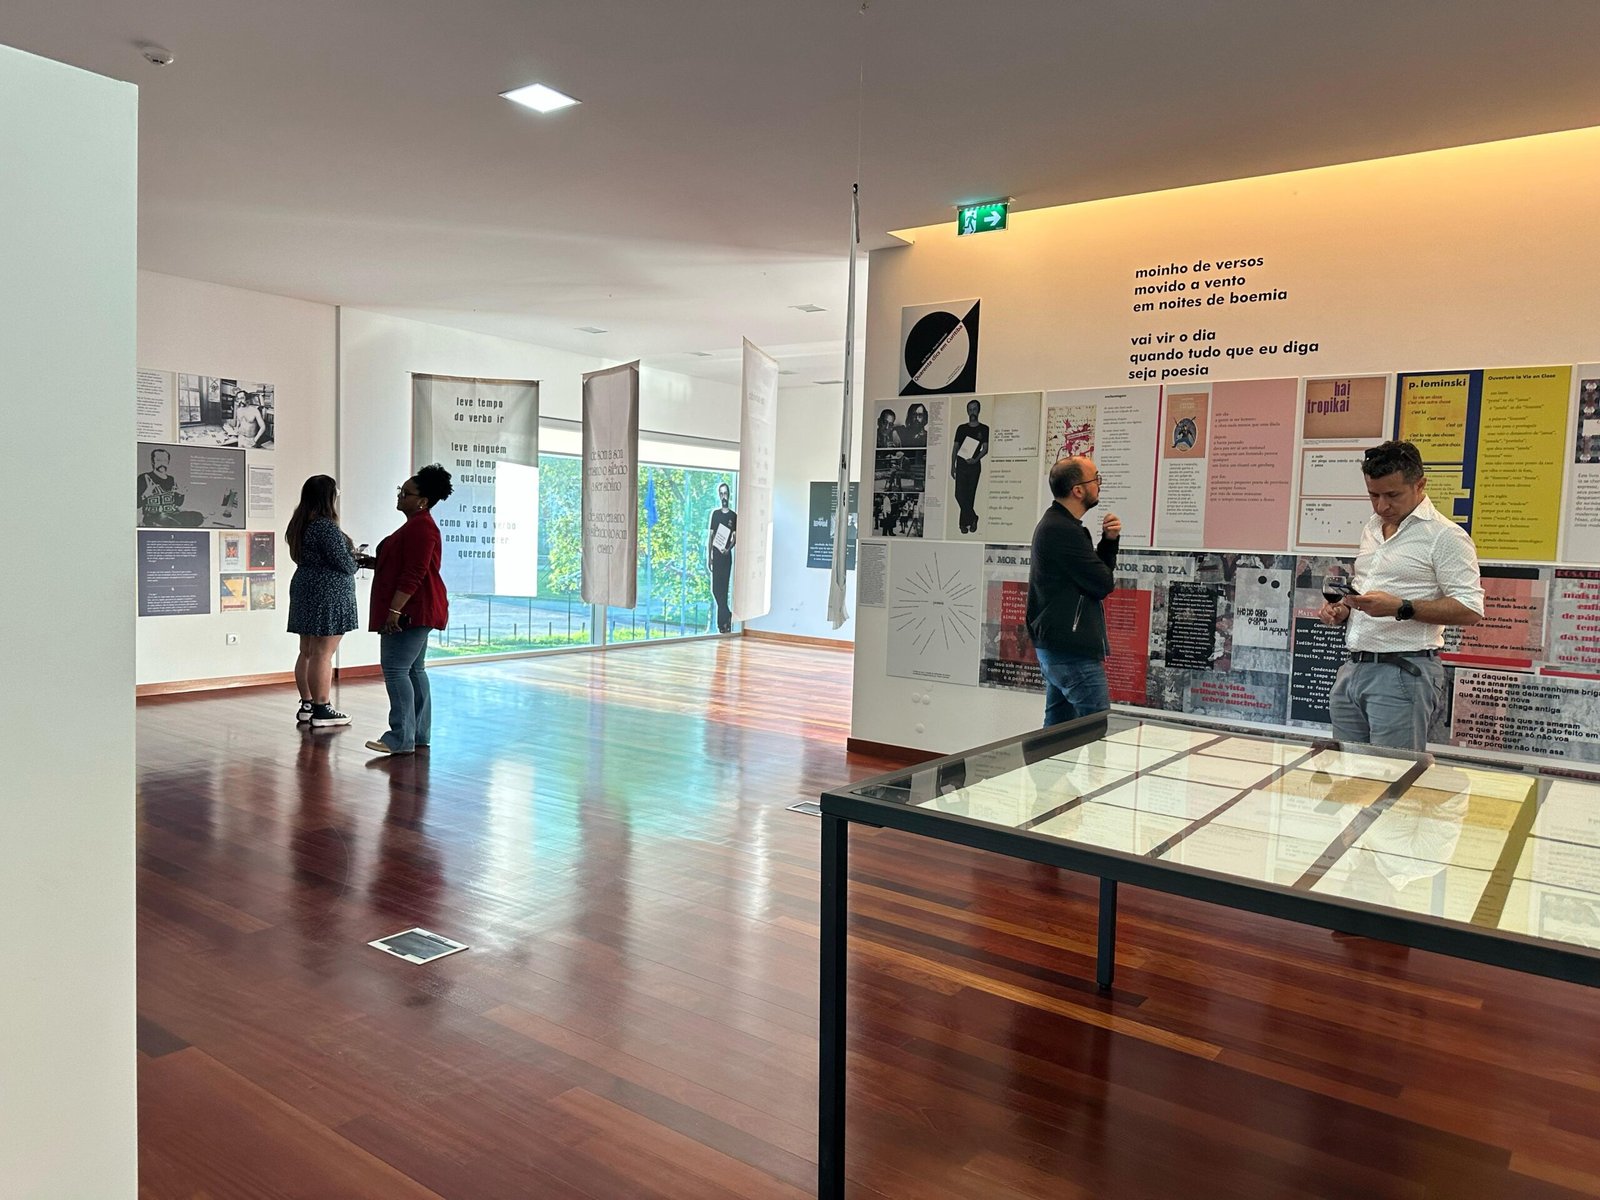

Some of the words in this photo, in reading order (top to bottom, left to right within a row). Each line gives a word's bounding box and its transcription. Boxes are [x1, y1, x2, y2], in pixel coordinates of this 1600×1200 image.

[1135, 263, 1188, 279] moinho
[1193, 260, 1211, 273] de
[1216, 257, 1264, 270] versos
[1134, 280, 1186, 295] movido
[1191, 281, 1200, 290] a
[1204, 275, 1246, 288] vento
[1133, 302, 1154, 312] em
[1159, 297, 1202, 310] noites
[1206, 293, 1225, 306] de
[1230, 288, 1288, 304] boemia
[1131, 333, 1151, 346] vai
[1156, 331, 1175, 344] vir
[1179, 333, 1188, 342] o
[1193, 329, 1216, 342] dia
[914, 361, 933, 381] Quarenta
[932, 352, 941, 361] clics
[940, 343, 948, 352] em
[946, 324, 963, 344] Curitiba
[1130, 348, 1184, 365] quando
[1188, 345, 1221, 359] tudo
[1226, 345, 1254, 359] que
[1259, 345, 1278, 355] eu
[1283, 340, 1319, 355] diga
[1128, 367, 1157, 381] seja
[1161, 364, 1209, 380] poesia
[1334, 380, 1351, 397] hai
[456, 397, 474, 407] leve
[477, 398, 503, 410] tempo
[1307, 396, 1350, 416] tropikai
[454, 412, 464, 422] do
[469, 413, 492, 423] verbo
[497, 414, 505, 423] ir
[451, 442, 468, 452] leve
[473, 443, 507, 455] ninguém
[456, 459, 472, 467] num
[460, 473, 497, 484] qualquer
[459, 504, 467, 513] ir
[472, 504, 497, 514] sendo
[440, 519, 461, 528] como
[466, 519, 478, 529] vai
[483, 521, 488, 529] o
[445, 533, 477, 544] nenhum
[458, 549, 496, 560] querendo
[986, 555, 994, 564] A
[997, 556, 1017, 565] MOR
[1141, 564, 1164, 574] ROR
[1167, 566, 1187, 575] IZA
[1481, 673, 1518, 682] daqueles
[1460, 678, 1475, 686] que
[1487, 681, 1520, 689] amaram
[1541, 685, 1580, 695] nenhuma
[1472, 686, 1503, 694] aqueles
[1522, 690, 1560, 700] deixaram
[1482, 693, 1509, 702] mágoa
[1471, 699, 1499, 707] virasse
[1508, 702, 1533, 712] chaga
[1535, 705, 1561, 714] antiga
[1475, 719, 1498, 727] saber
[1500, 722, 1515, 730] que
[1516, 724, 1538, 732] amar
[1546, 726, 1563, 736] pão
[1564, 728, 1584, 737] feito
[1479, 713, 1516, 723] daqueles
[1546, 721, 1581, 730] amaram
[1456, 731, 1484, 740] porque
[1502, 736, 1521, 744] quer
[1500, 728, 1523, 738] pedra
[1525, 731, 1535, 739] só
[1537, 732, 1553, 740] não
[1467, 738, 1483, 746] não
[1484, 741, 1513, 750] porque
[1515, 744, 1530, 752] não
[1532, 746, 1547, 754] tem
